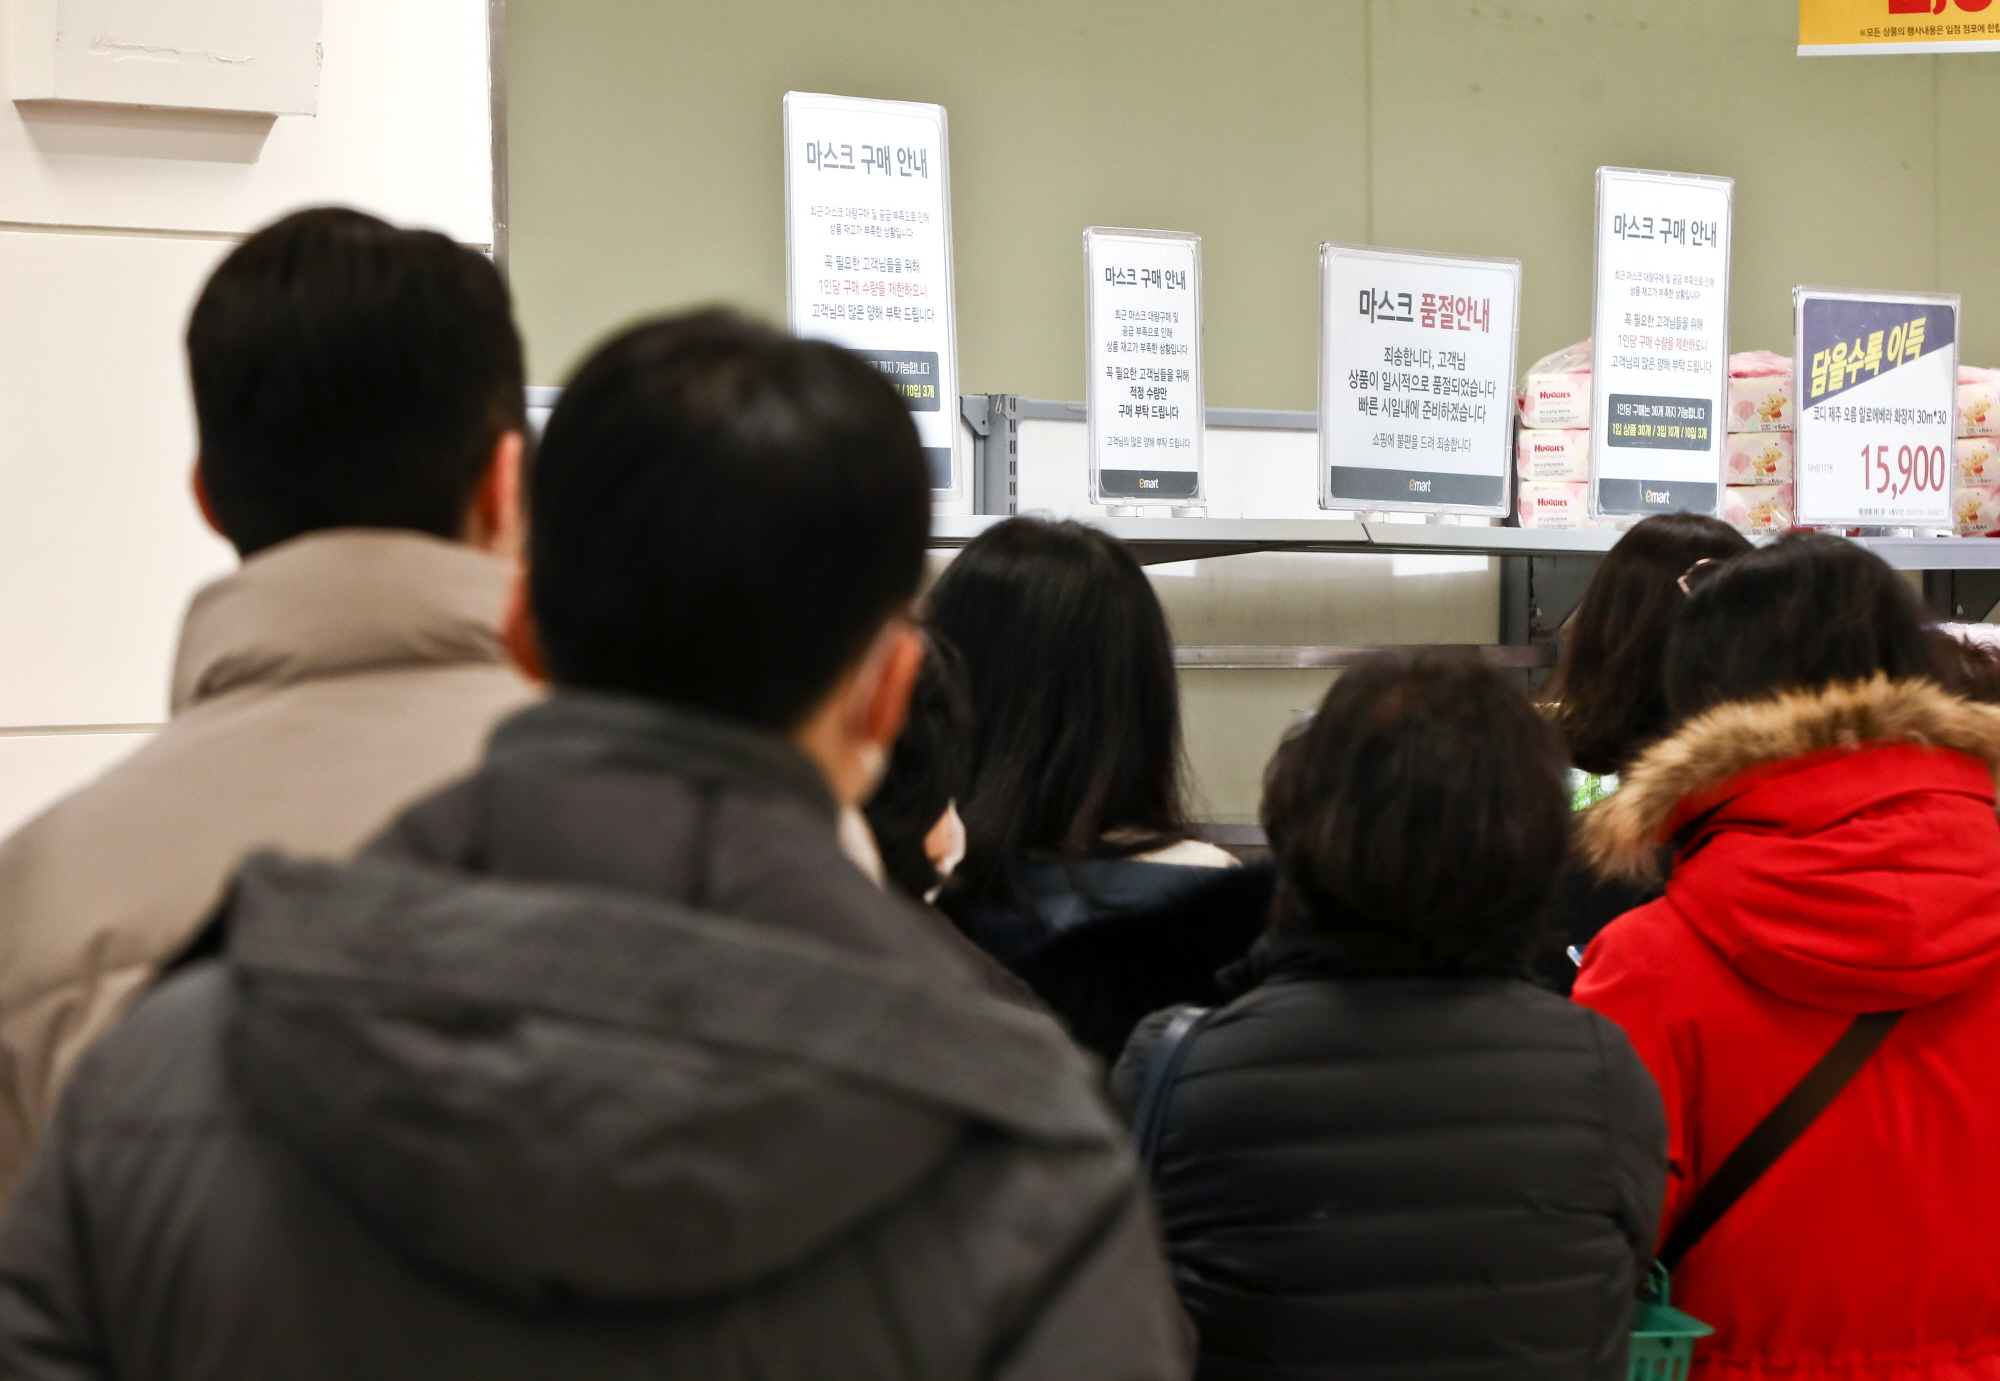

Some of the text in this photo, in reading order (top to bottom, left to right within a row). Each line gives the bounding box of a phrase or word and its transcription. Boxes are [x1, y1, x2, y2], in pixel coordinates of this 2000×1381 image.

[1883, 27, 1904, 36] 상품의
[1907, 26, 1944, 36] 행사내용은
[1946, 25, 1961, 34] 입점
[1963, 24, 1985, 34] 점포에
[807, 140, 927, 178] 마스크 구매 안내
[811, 206, 929, 223] 최근 마스크 대량구매 및 공급 부족으로 인해
[830, 224, 913, 239] 상품 재고가 부족한 상황입니다
[1614, 213, 1716, 248] 마스크 구매 안내
[825, 255, 920, 274] 꼭 필요한 고객님들을 위해
[1105, 266, 1186, 290] 마스크 구매 안내
[819, 279, 927, 298] 1인당 구매 수량을 제한하오니
[1630, 286, 1700, 300] 상품 재고가 부족한 상황입니다
[812, 304, 934, 323] 고객님의 많은 양해 부탁 드립니다
[1115, 309, 1178, 323] 최근 마스크 대량구매 및
[1360, 288, 1490, 333] 마스크 품절안내
[1625, 313, 1703, 331] 꼭 필요한 고객님들을 위해
[1122, 326, 1172, 338] 공급 부족으로 인해
[1107, 341, 1188, 355] 상품 재고가 부족한 상황입니다
[1618, 334, 1707, 352] 1인당 구매 수량을 제한하오니
[1384, 347, 1465, 371] 죄송합니다, 고객님
[1612, 356, 1712, 373] 고객님의 많은 양해 부탁 드립니다
[1811, 317, 1926, 398] 담을수록 이득
[880, 361, 894, 374] 까지
[896, 362, 930, 375] 가능합니다
[1106, 366, 1189, 382] 꼭 필요한 고객님들을 위해
[907, 385, 921, 397] 10입
[923, 385, 935, 398] 3개
[1348, 369, 1496, 399] 상품이 일시적으로 품절되었습니다
[1130, 386, 1167, 400] 적정 수량만
[1119, 405, 1179, 419] 구매 부탁 드립니다
[1358, 396, 1486, 424] 빠른 시일내에 준비하겠습니다
[1617, 404, 1704, 419] 1인당 구매는 30개 까지 가능합니다
[1813, 406, 1826, 422] 코디
[1829, 406, 1841, 423] 제주
[1844, 407, 1857, 422] 오름
[1859, 408, 1892, 424] 알로에베라
[1894, 409, 1914, 425] 화장지
[1613, 423, 1707, 439] 1입 상품 30개 / 3입 10개 / 10입 3개
[1107, 436, 1190, 448] 고객님의 많은 양해 부탁 드립니다
[1373, 433, 1471, 453] 쇼핑에 불편을 드려 죄송합니다
[1861, 444, 1945, 500] 15,900
[1140, 478, 1158, 489] emart
[1409, 479, 1431, 493] emart
[1646, 490, 1670, 504] emart
